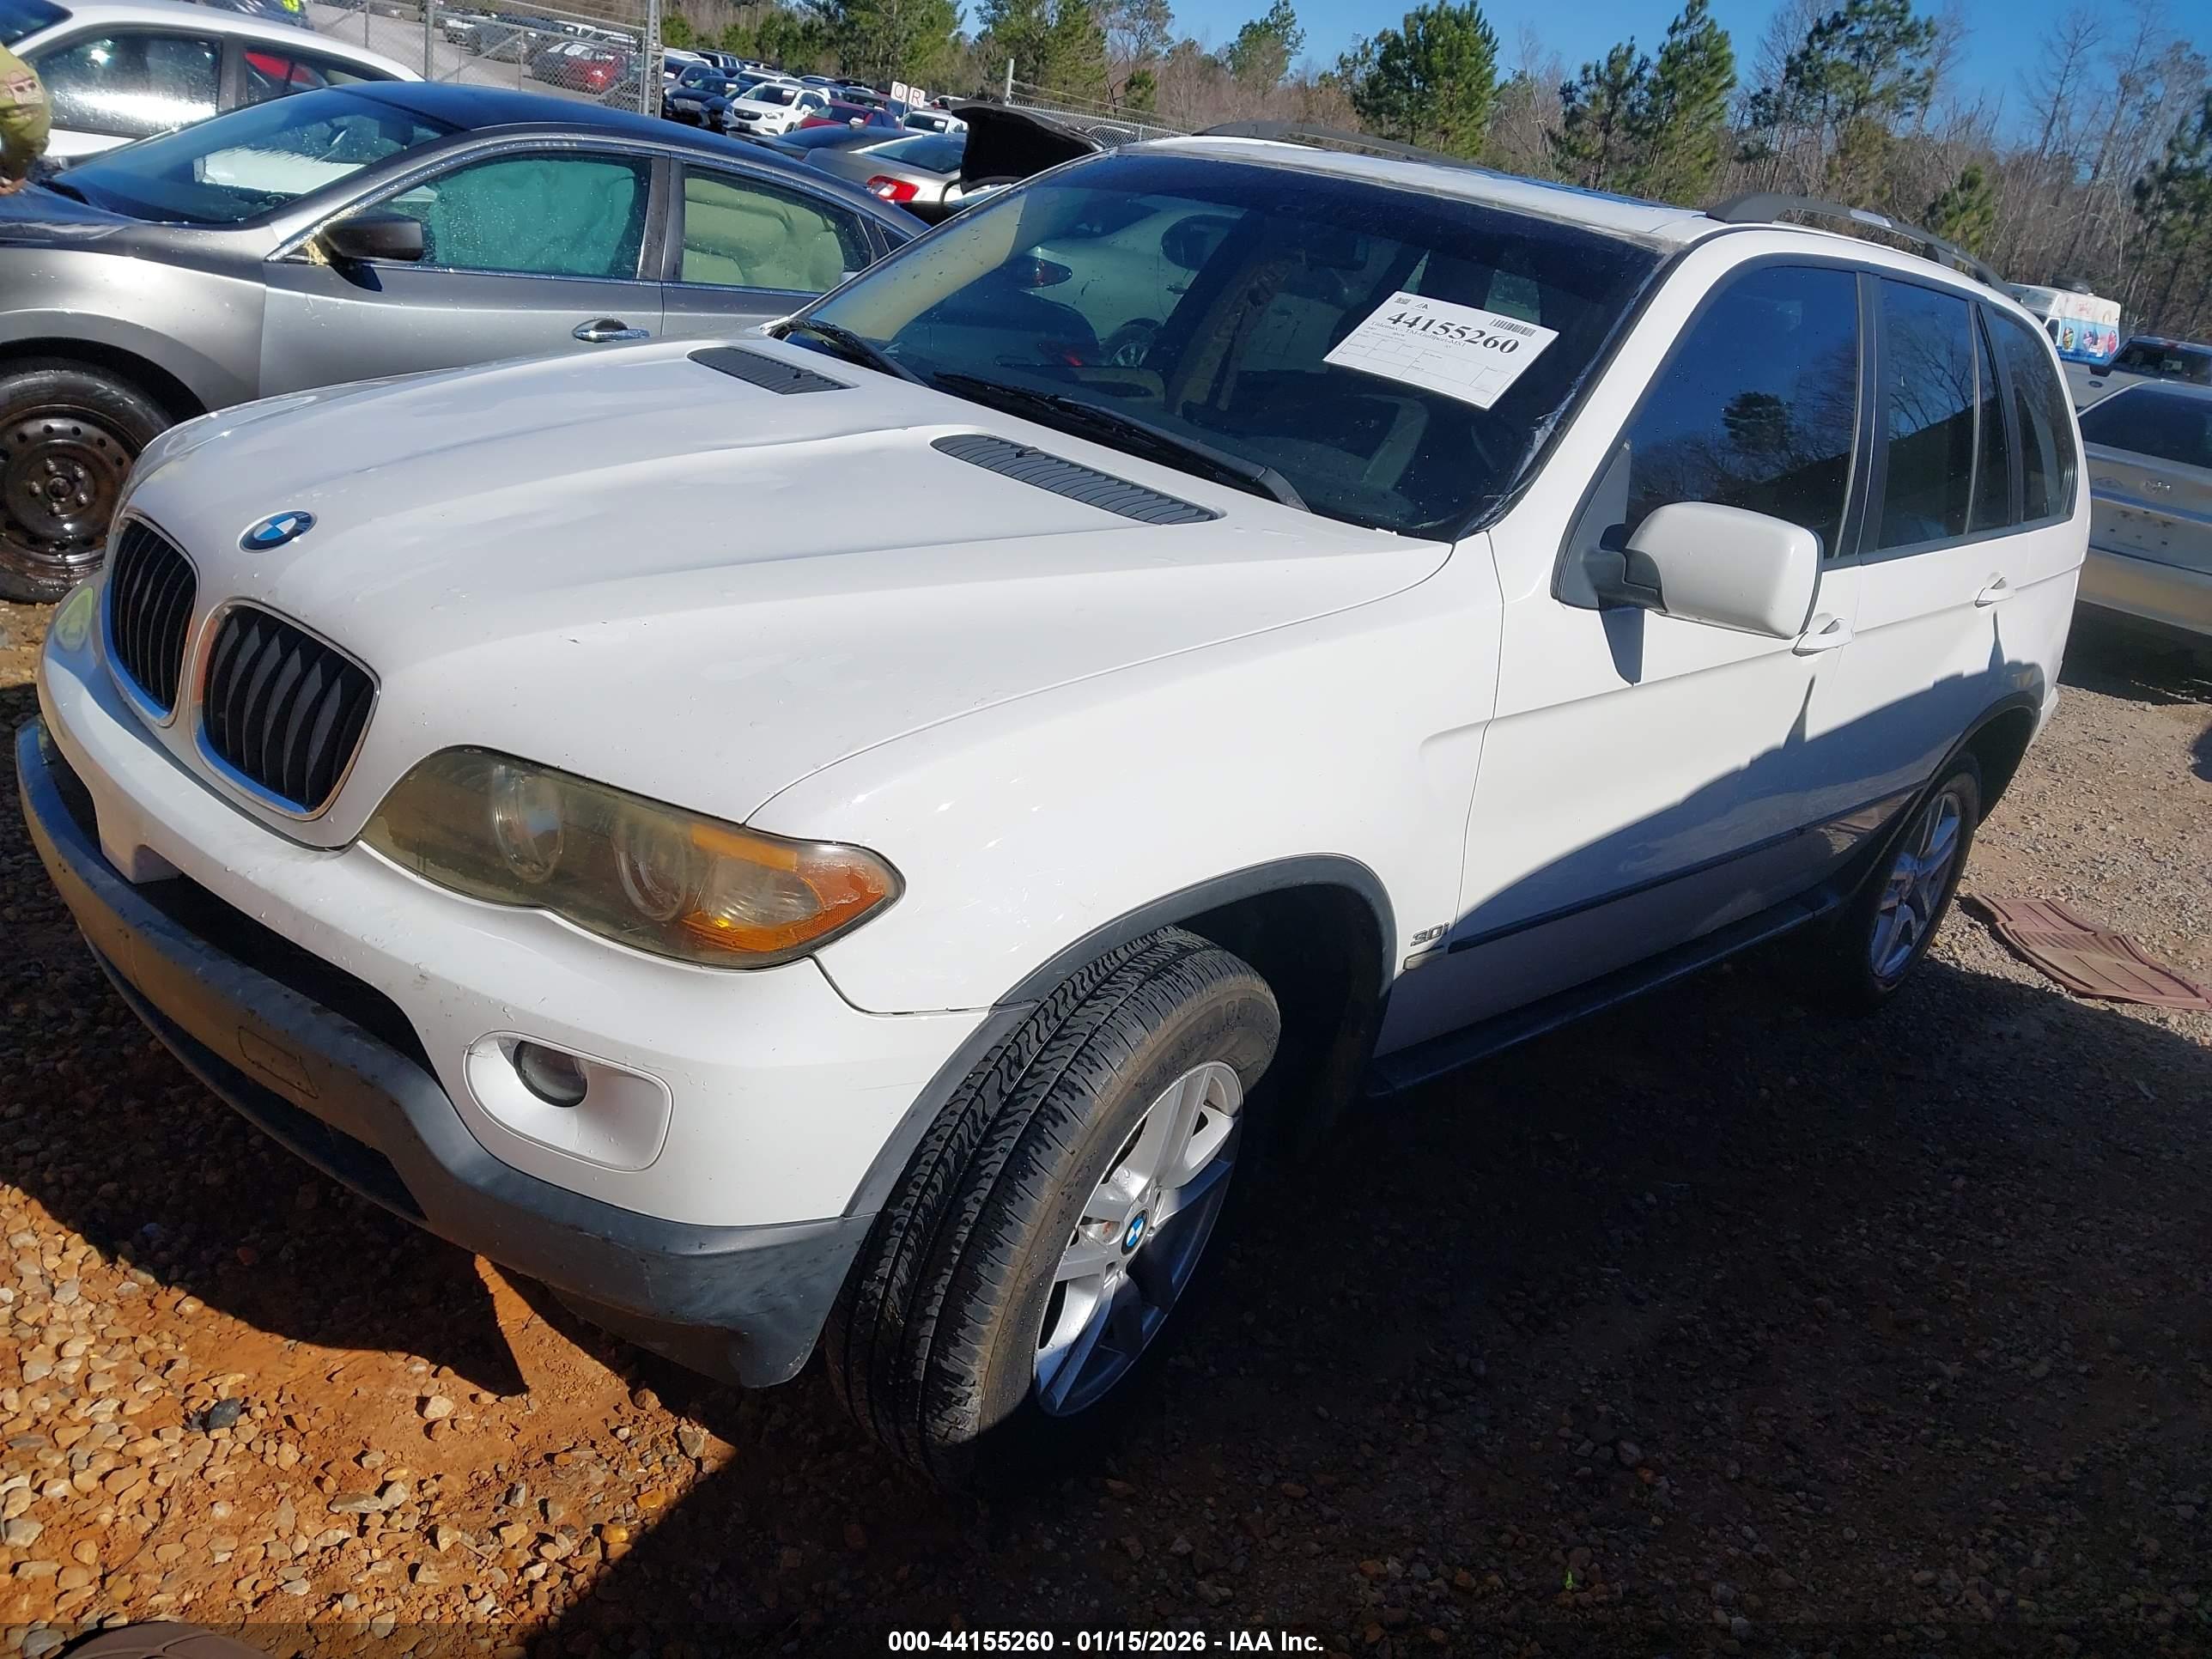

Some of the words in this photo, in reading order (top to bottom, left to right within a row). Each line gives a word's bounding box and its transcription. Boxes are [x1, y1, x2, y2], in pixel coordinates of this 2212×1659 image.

[894, 83, 904, 100] Q
[911, 89, 921, 106] R
[1387, 312, 1519, 354] 44155260
